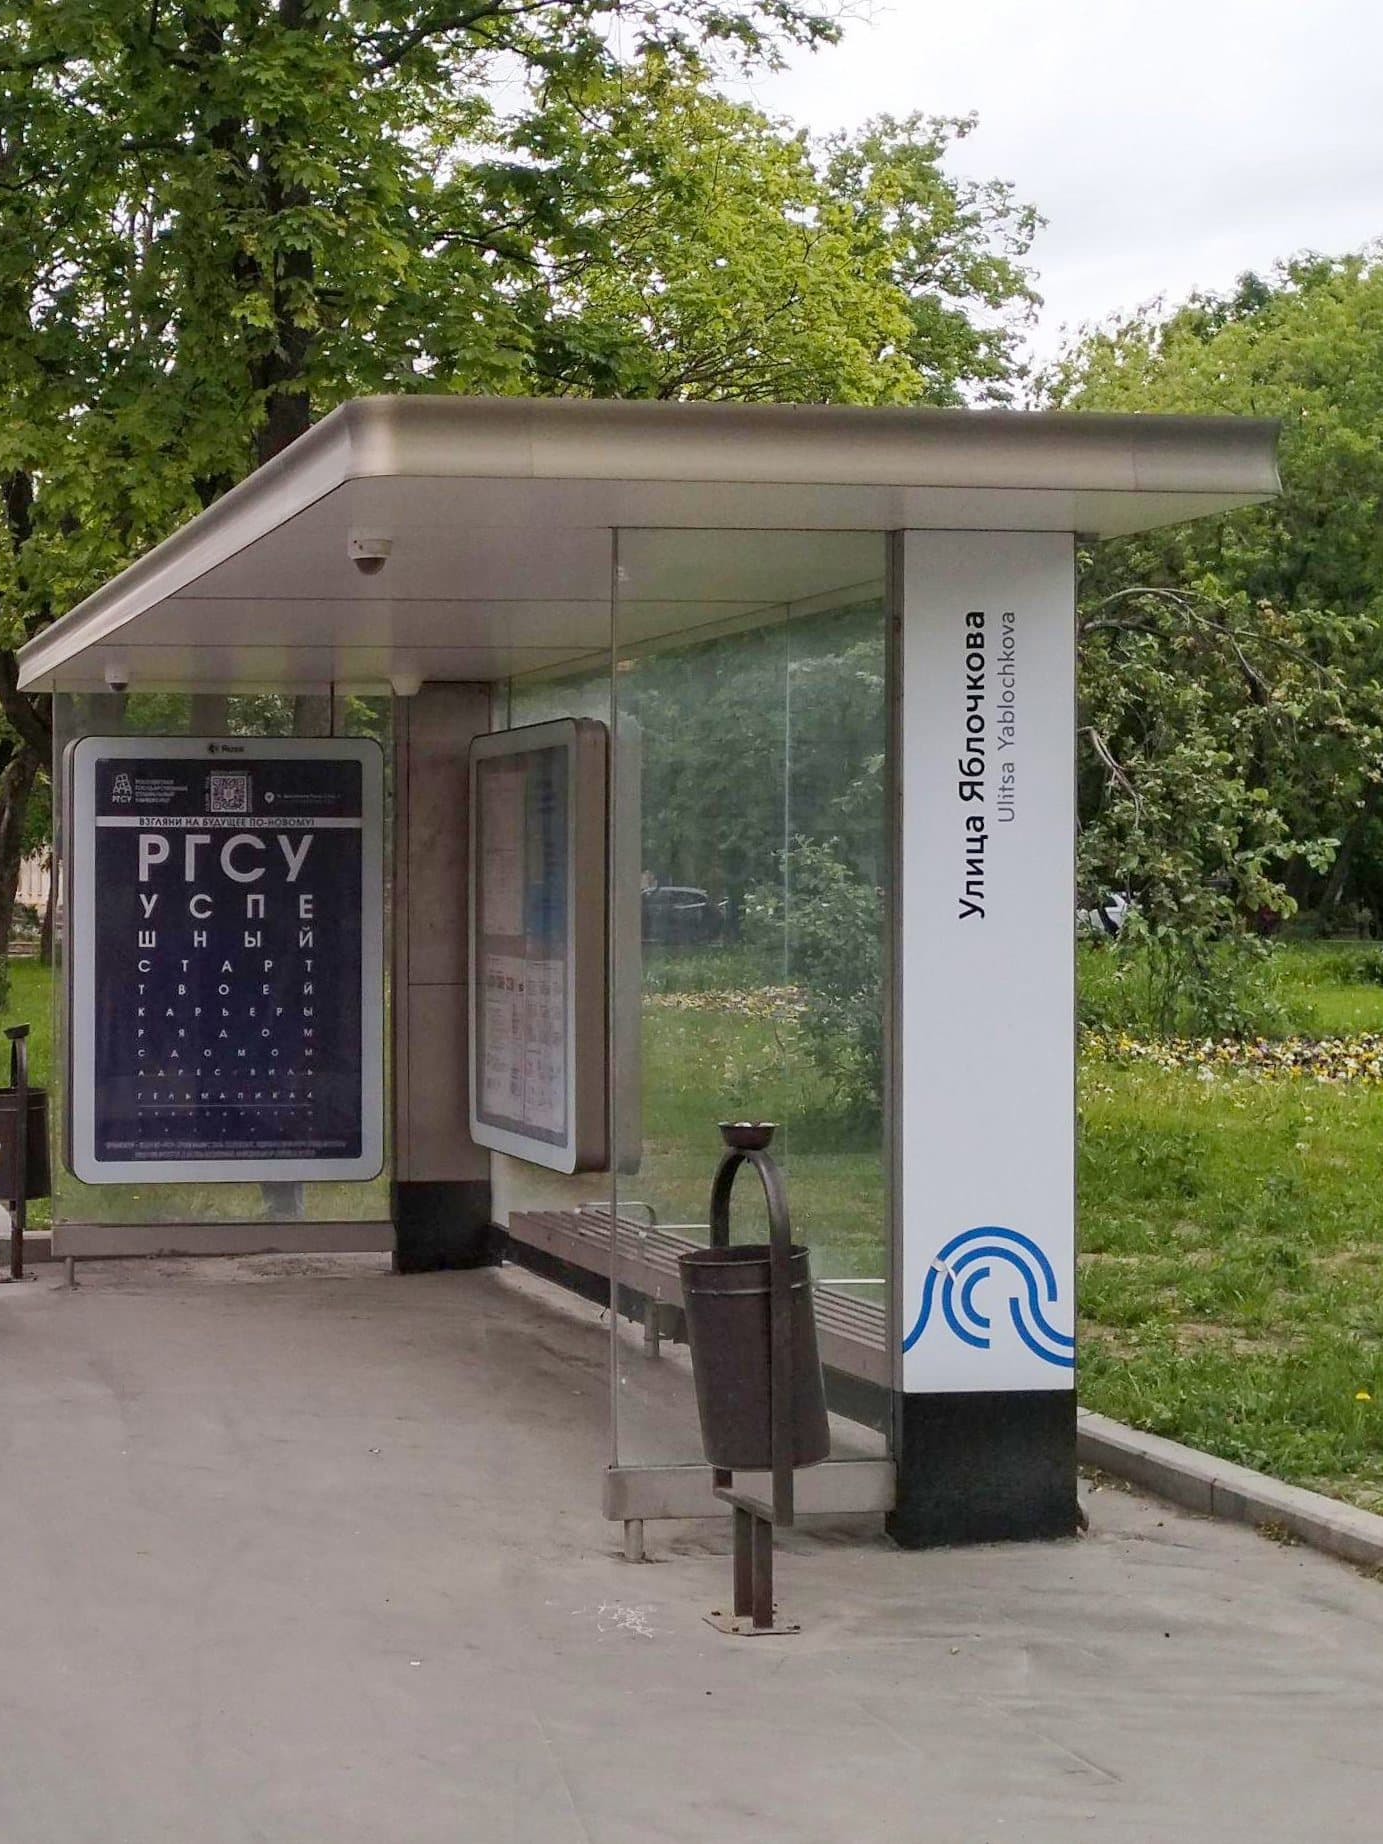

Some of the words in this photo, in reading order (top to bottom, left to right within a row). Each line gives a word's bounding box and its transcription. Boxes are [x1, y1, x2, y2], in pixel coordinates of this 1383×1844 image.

[957, 611, 985, 802] Яблочкова
[997, 611, 1015, 751] Yablochkova
[139, 817, 182, 827] ВЗГЛЯНИ
[186, 817, 200, 827] НА
[202, 817, 246, 828] БУДУЩЕЕ
[997, 761, 1015, 823] Ulitsa
[138, 834, 314, 882] РГСУ
[958, 815, 988, 919] Улица
